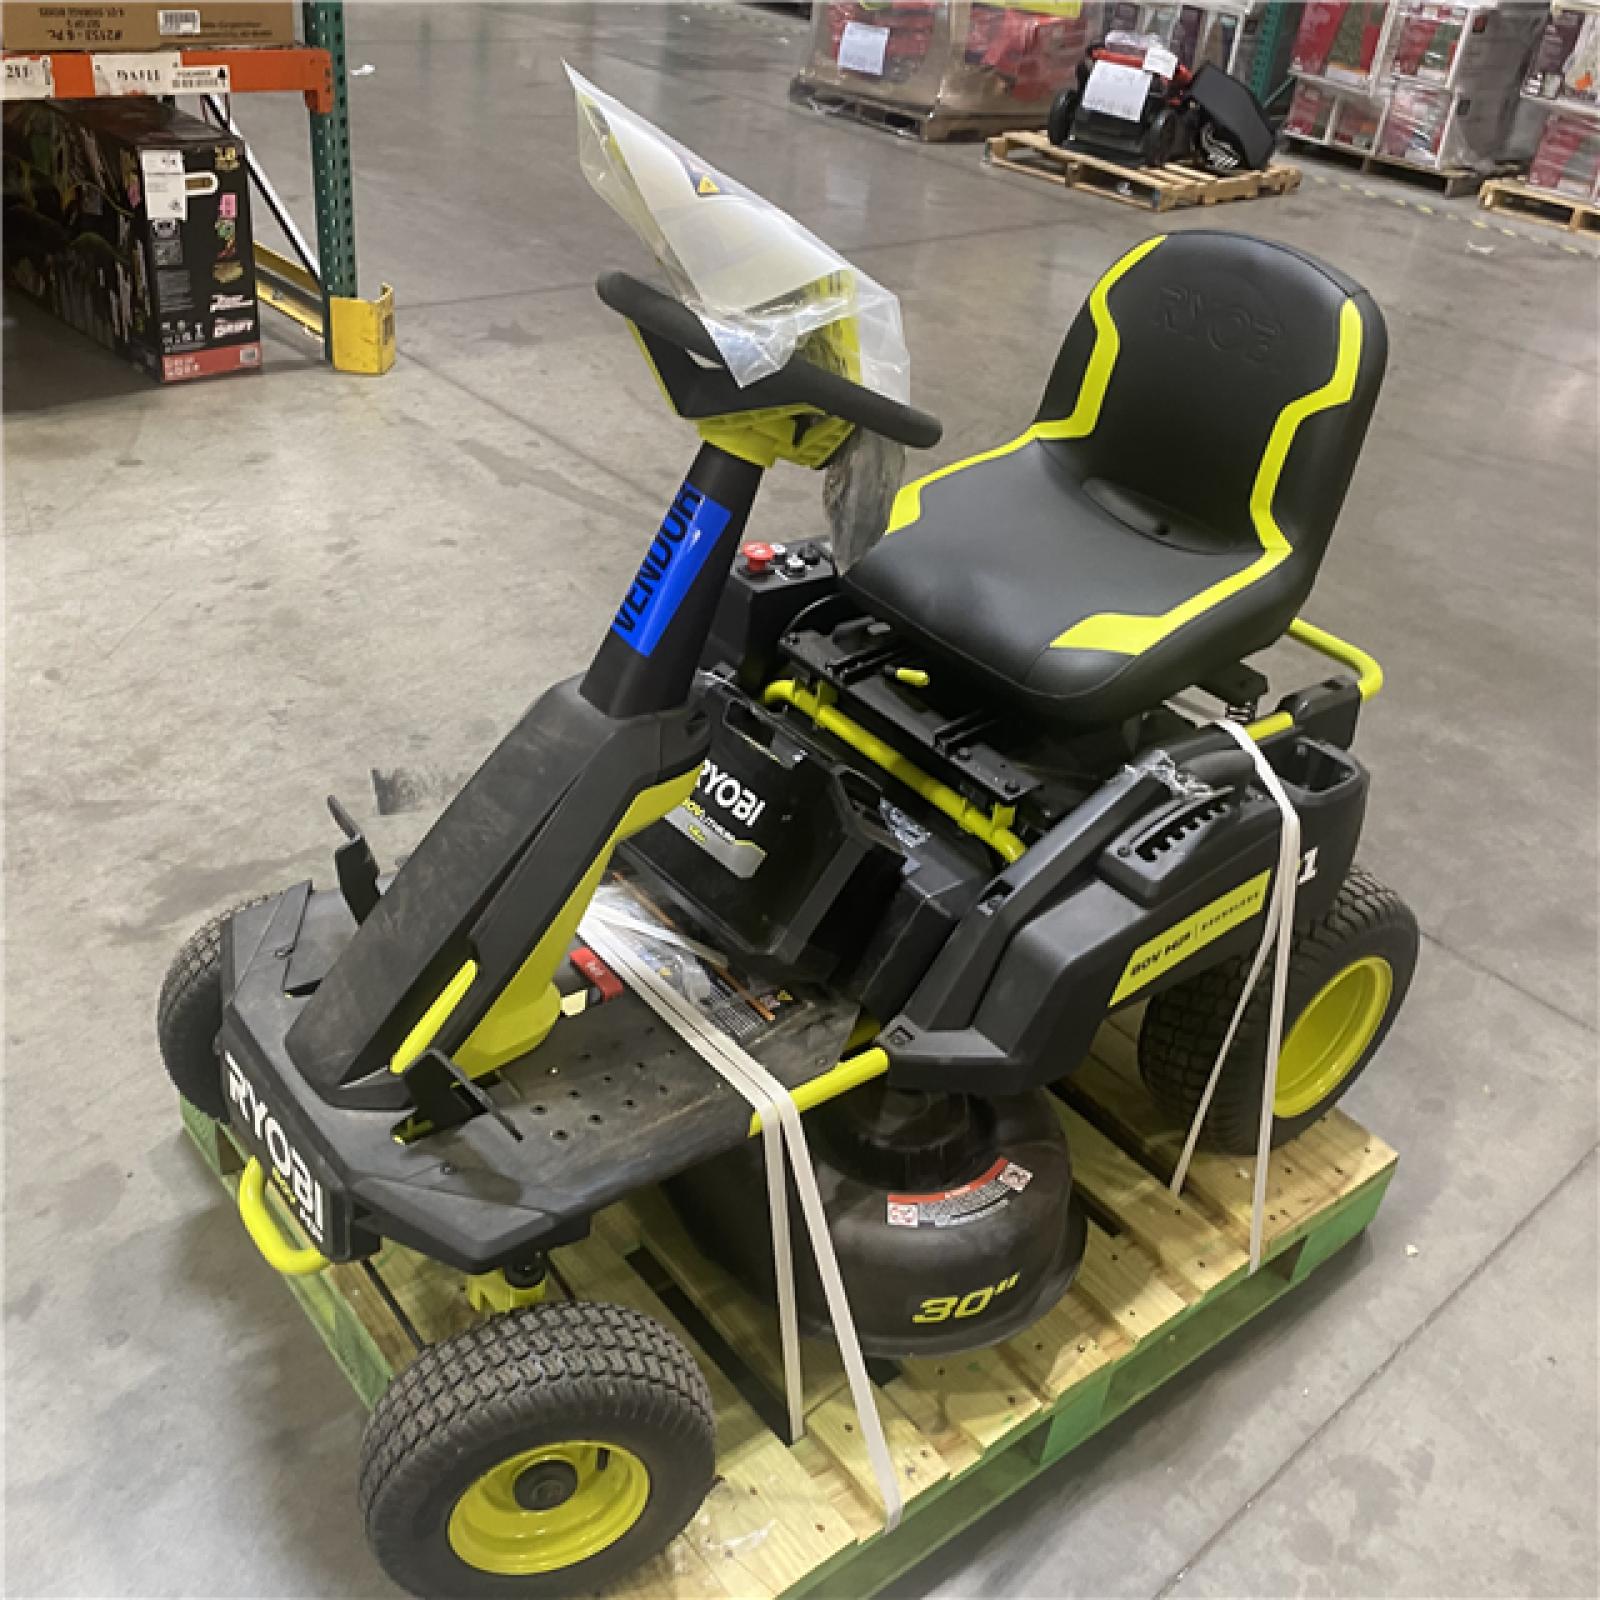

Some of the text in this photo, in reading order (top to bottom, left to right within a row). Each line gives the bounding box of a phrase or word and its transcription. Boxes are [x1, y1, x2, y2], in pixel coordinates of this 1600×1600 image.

[1155, 284, 1290, 368] RYOB
[224, 1049, 324, 1231] RYOBI
[911, 1271, 1022, 1324] 30"
